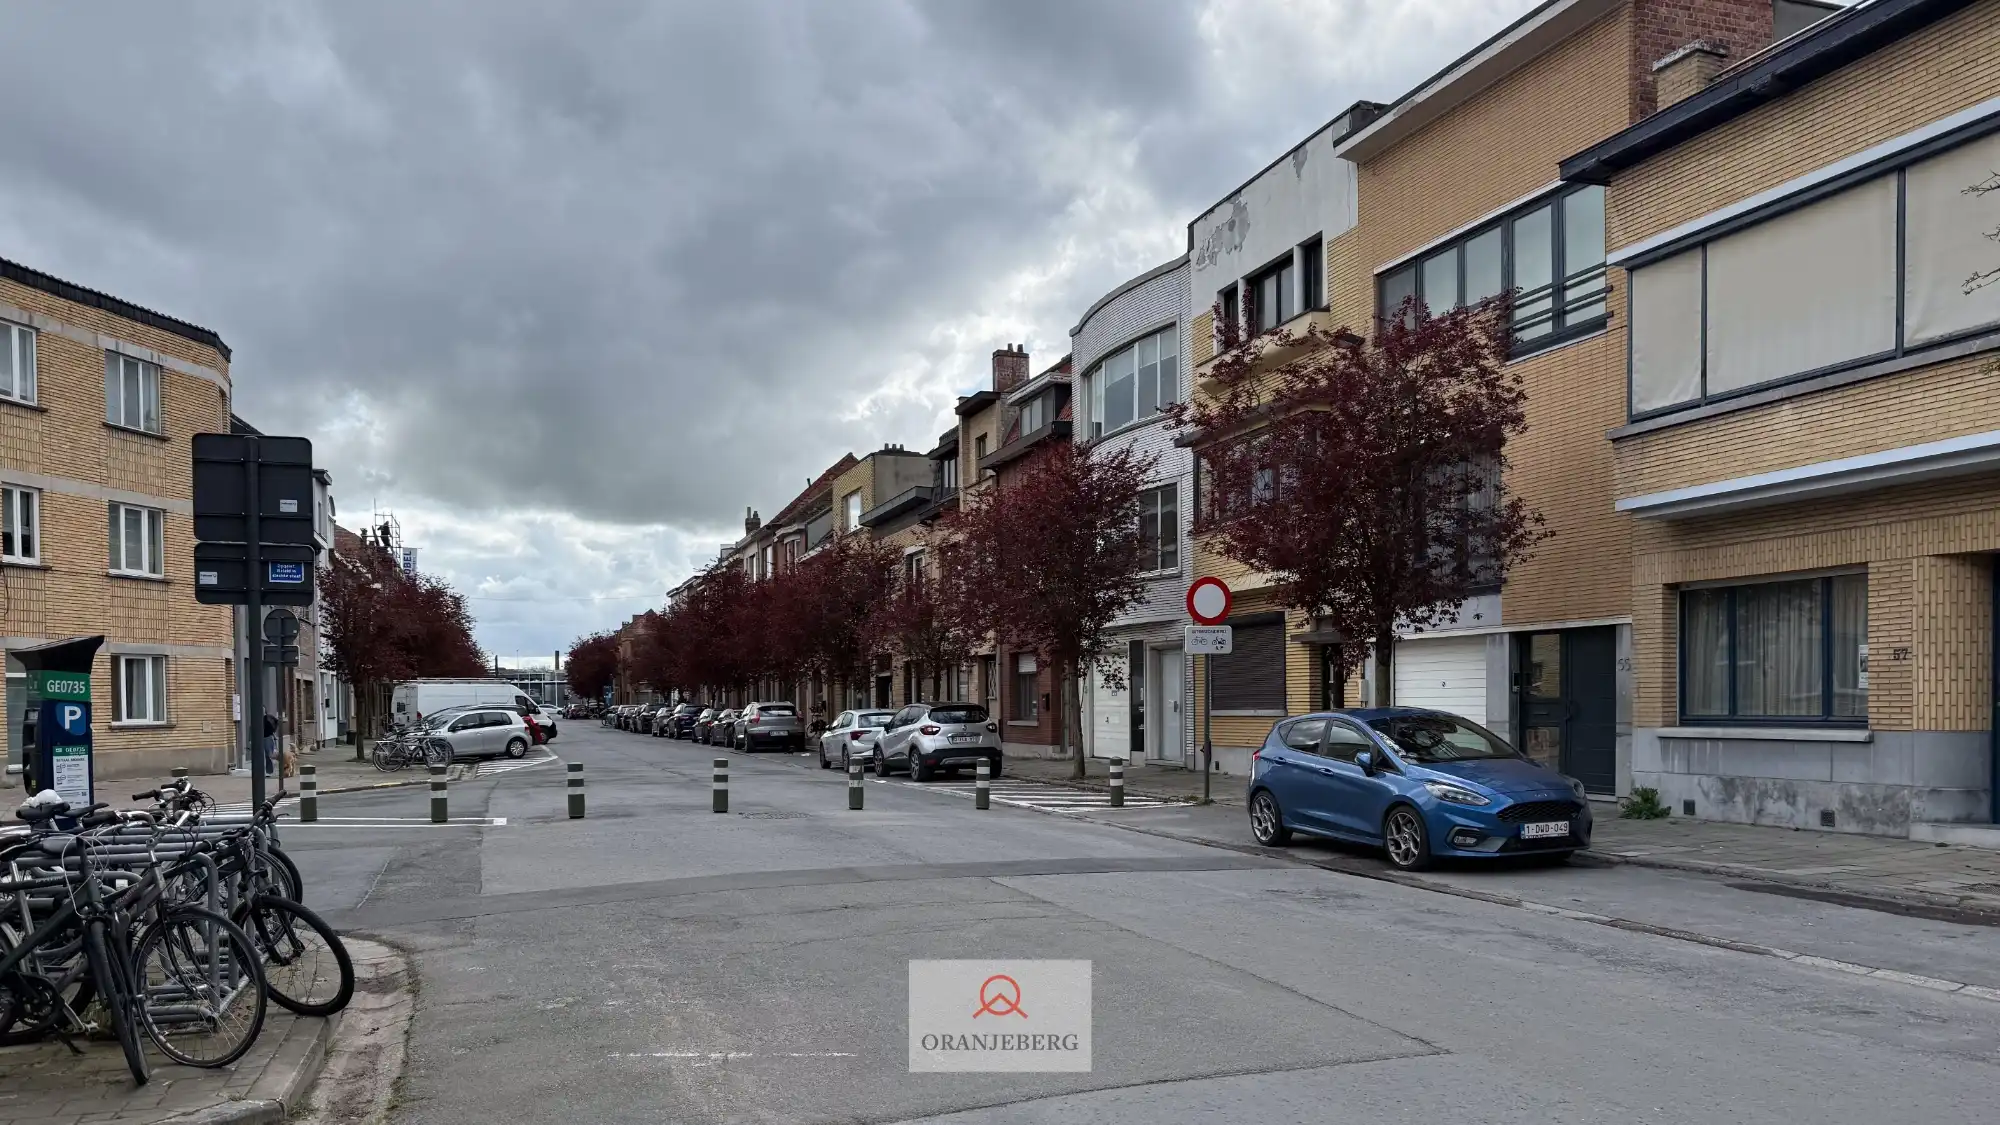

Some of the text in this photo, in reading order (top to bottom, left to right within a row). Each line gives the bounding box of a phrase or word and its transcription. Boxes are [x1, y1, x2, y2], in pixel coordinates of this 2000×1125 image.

[1893, 648, 1908, 660] 57
[1618, 657, 1631, 671] 55
[46, 680, 86, 694] GE0735
[64, 705, 82, 730] P
